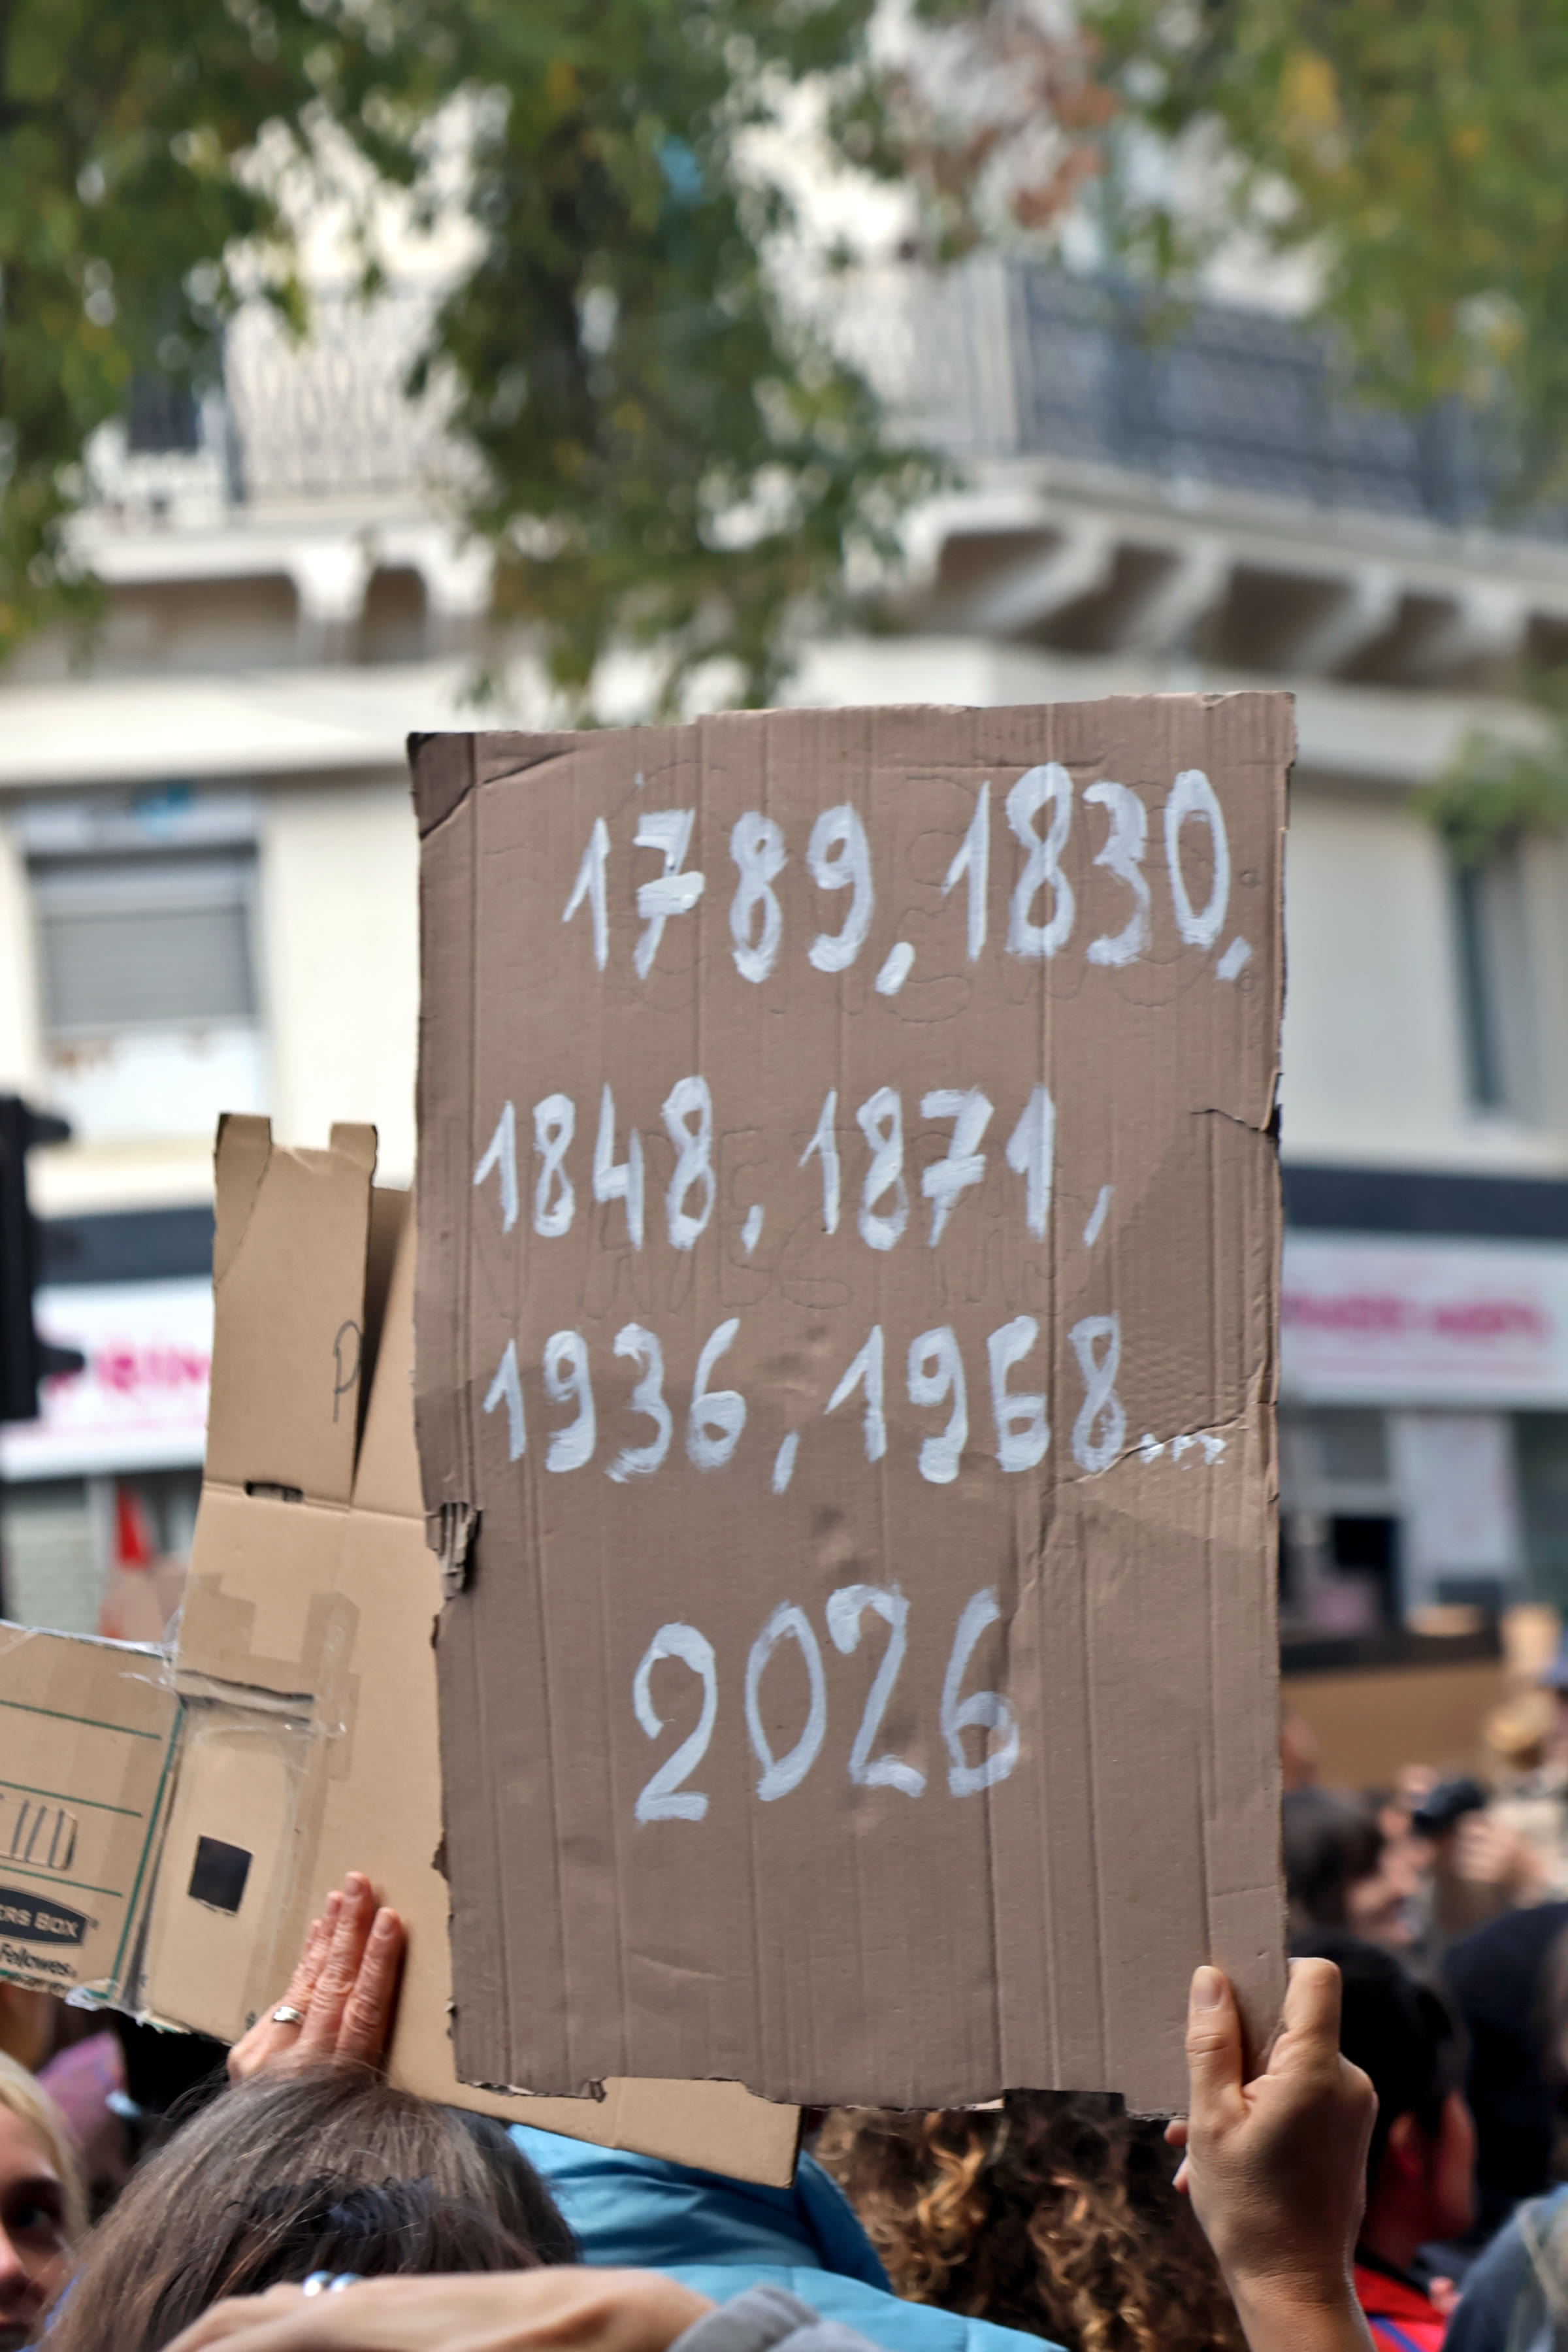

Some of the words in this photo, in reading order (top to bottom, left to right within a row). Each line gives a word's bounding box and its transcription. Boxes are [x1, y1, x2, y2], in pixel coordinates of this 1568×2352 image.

[561, 802, 914, 997] 1789,
[939, 760, 1252, 981] 1830,
[472, 1075, 764, 1253] 1848,
[798, 1085, 1112, 1249] 1871,
[482, 1316, 798, 1494] 1936,
[632, 1581, 1021, 1825] 2026
[34, 1911, 79, 1938] BOX
